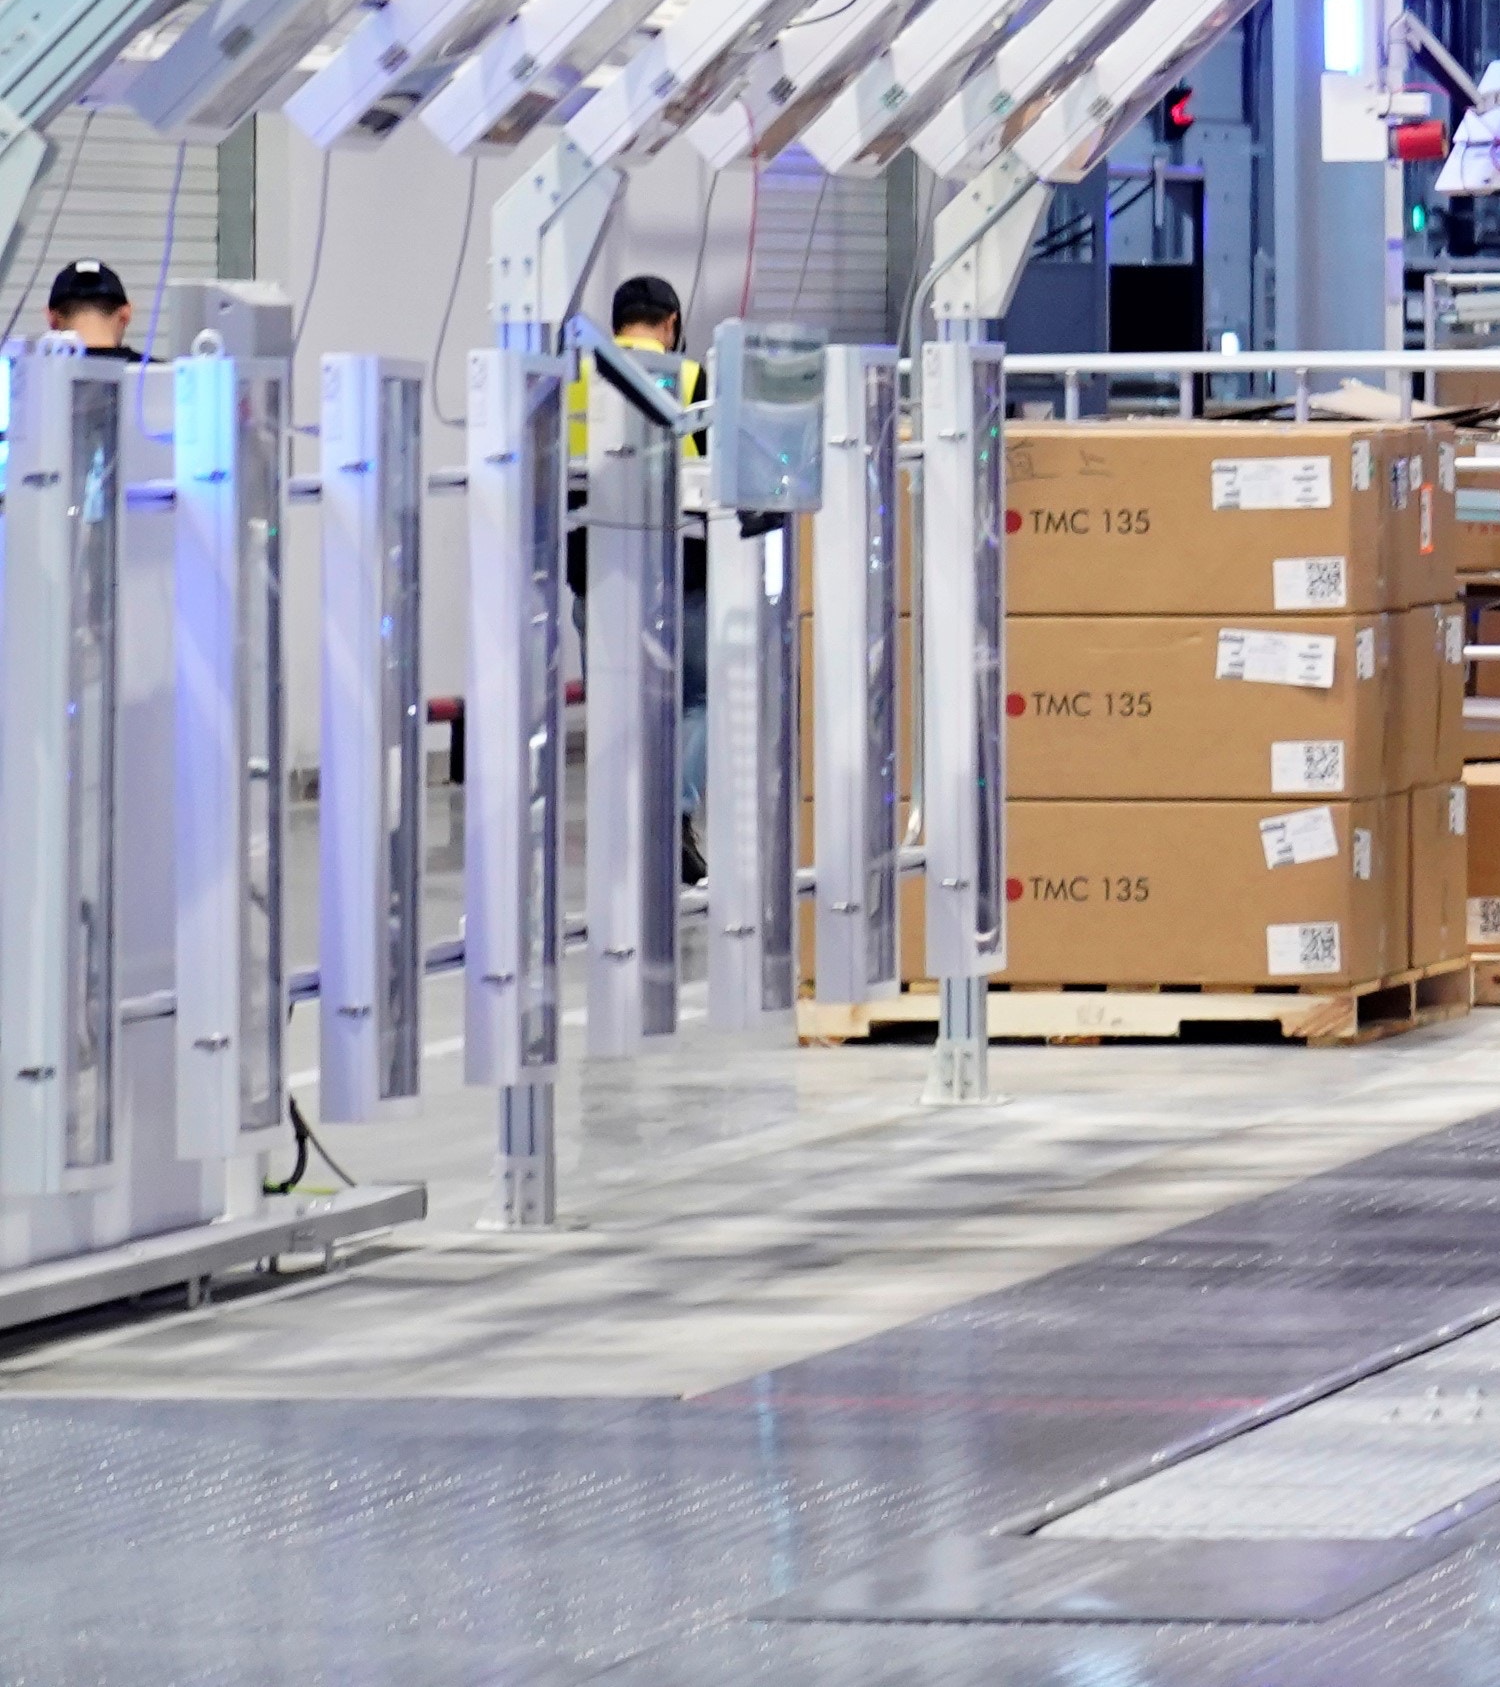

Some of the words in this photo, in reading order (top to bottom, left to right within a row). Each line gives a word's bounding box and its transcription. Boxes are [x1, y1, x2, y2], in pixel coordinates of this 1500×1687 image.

[1029, 508, 1089, 535] TMC
[1104, 508, 1151, 535] 135
[1032, 691, 1091, 718] TMC
[1105, 691, 1152, 718] 135
[1029, 876, 1088, 903] TMC
[1103, 876, 1150, 903] 135
